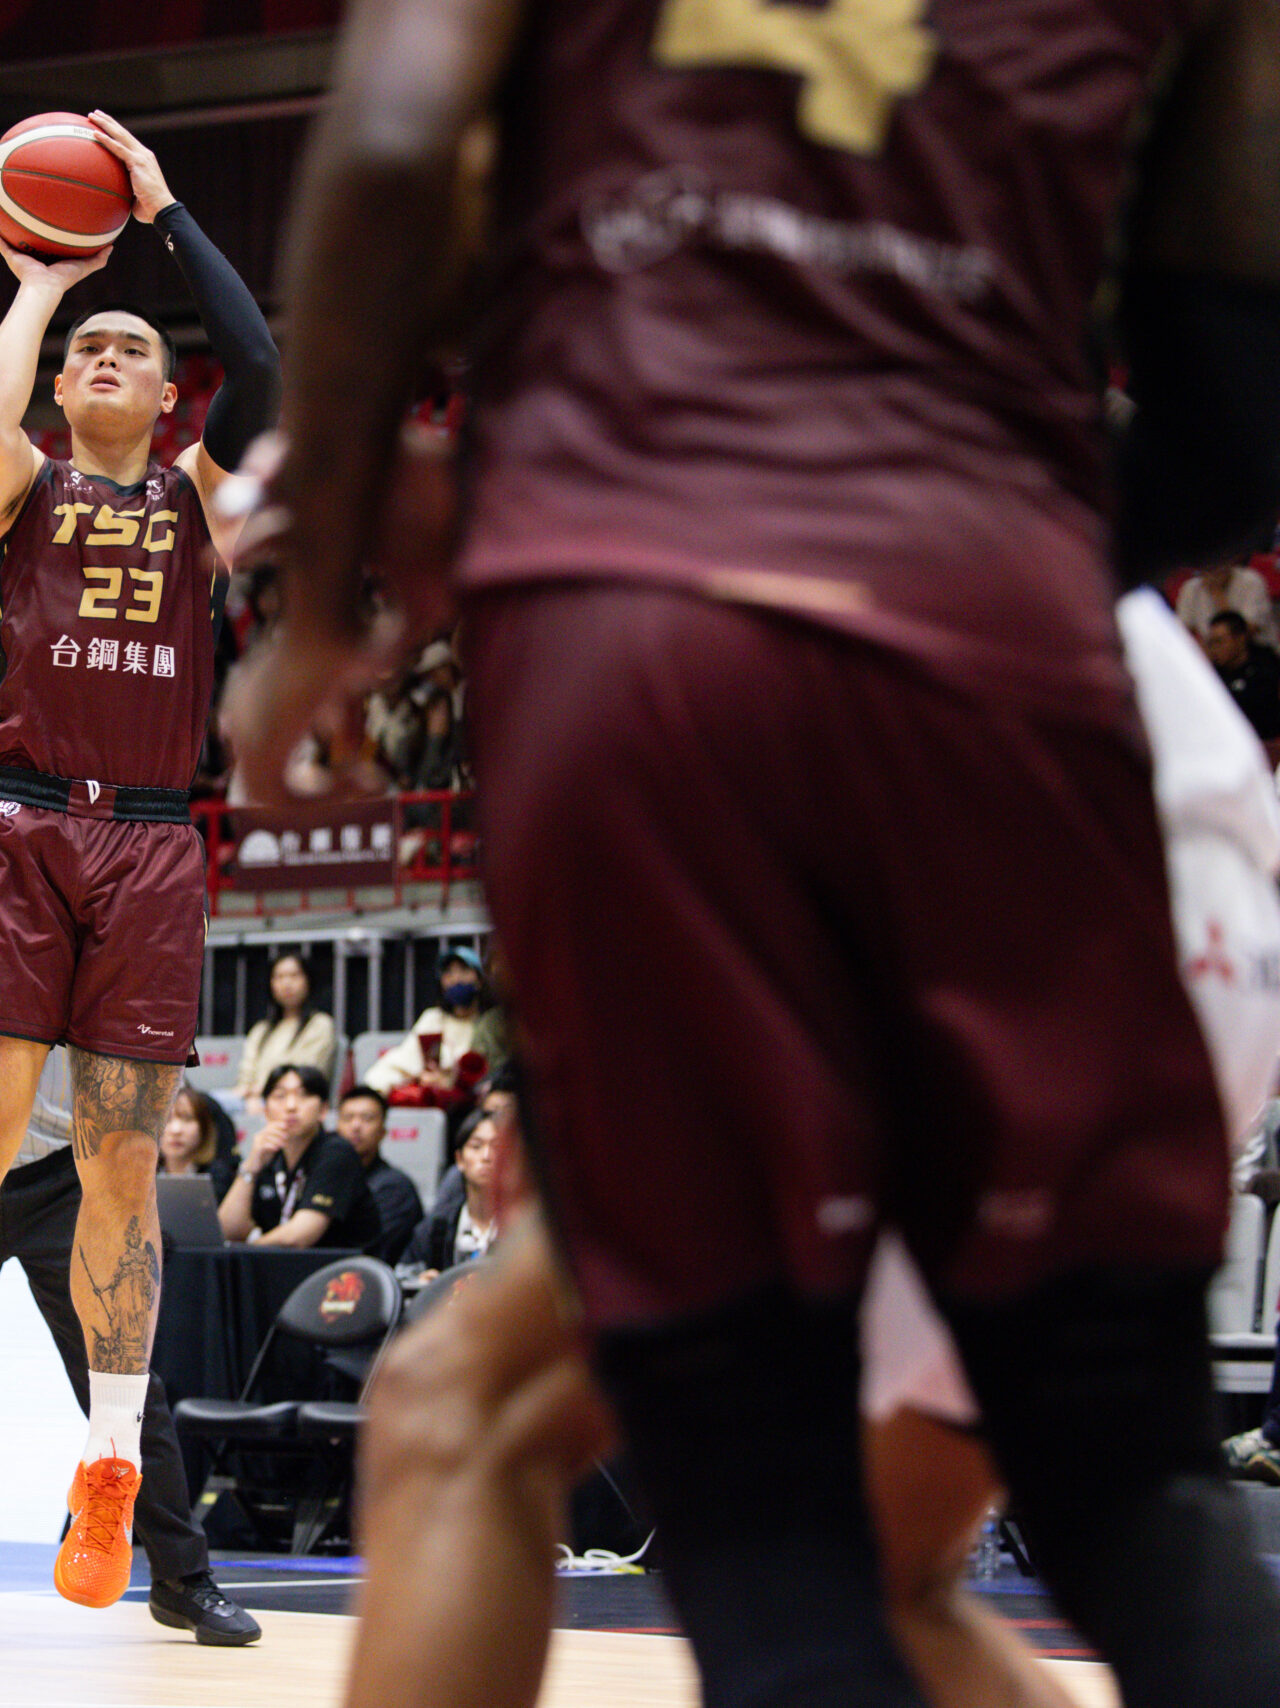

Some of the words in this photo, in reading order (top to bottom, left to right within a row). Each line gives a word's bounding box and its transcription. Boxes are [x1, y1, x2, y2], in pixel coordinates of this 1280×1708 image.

[51, 502, 178, 553] TSG
[78, 567, 164, 623] 23
[50, 634, 176, 678] 台鋼集團
